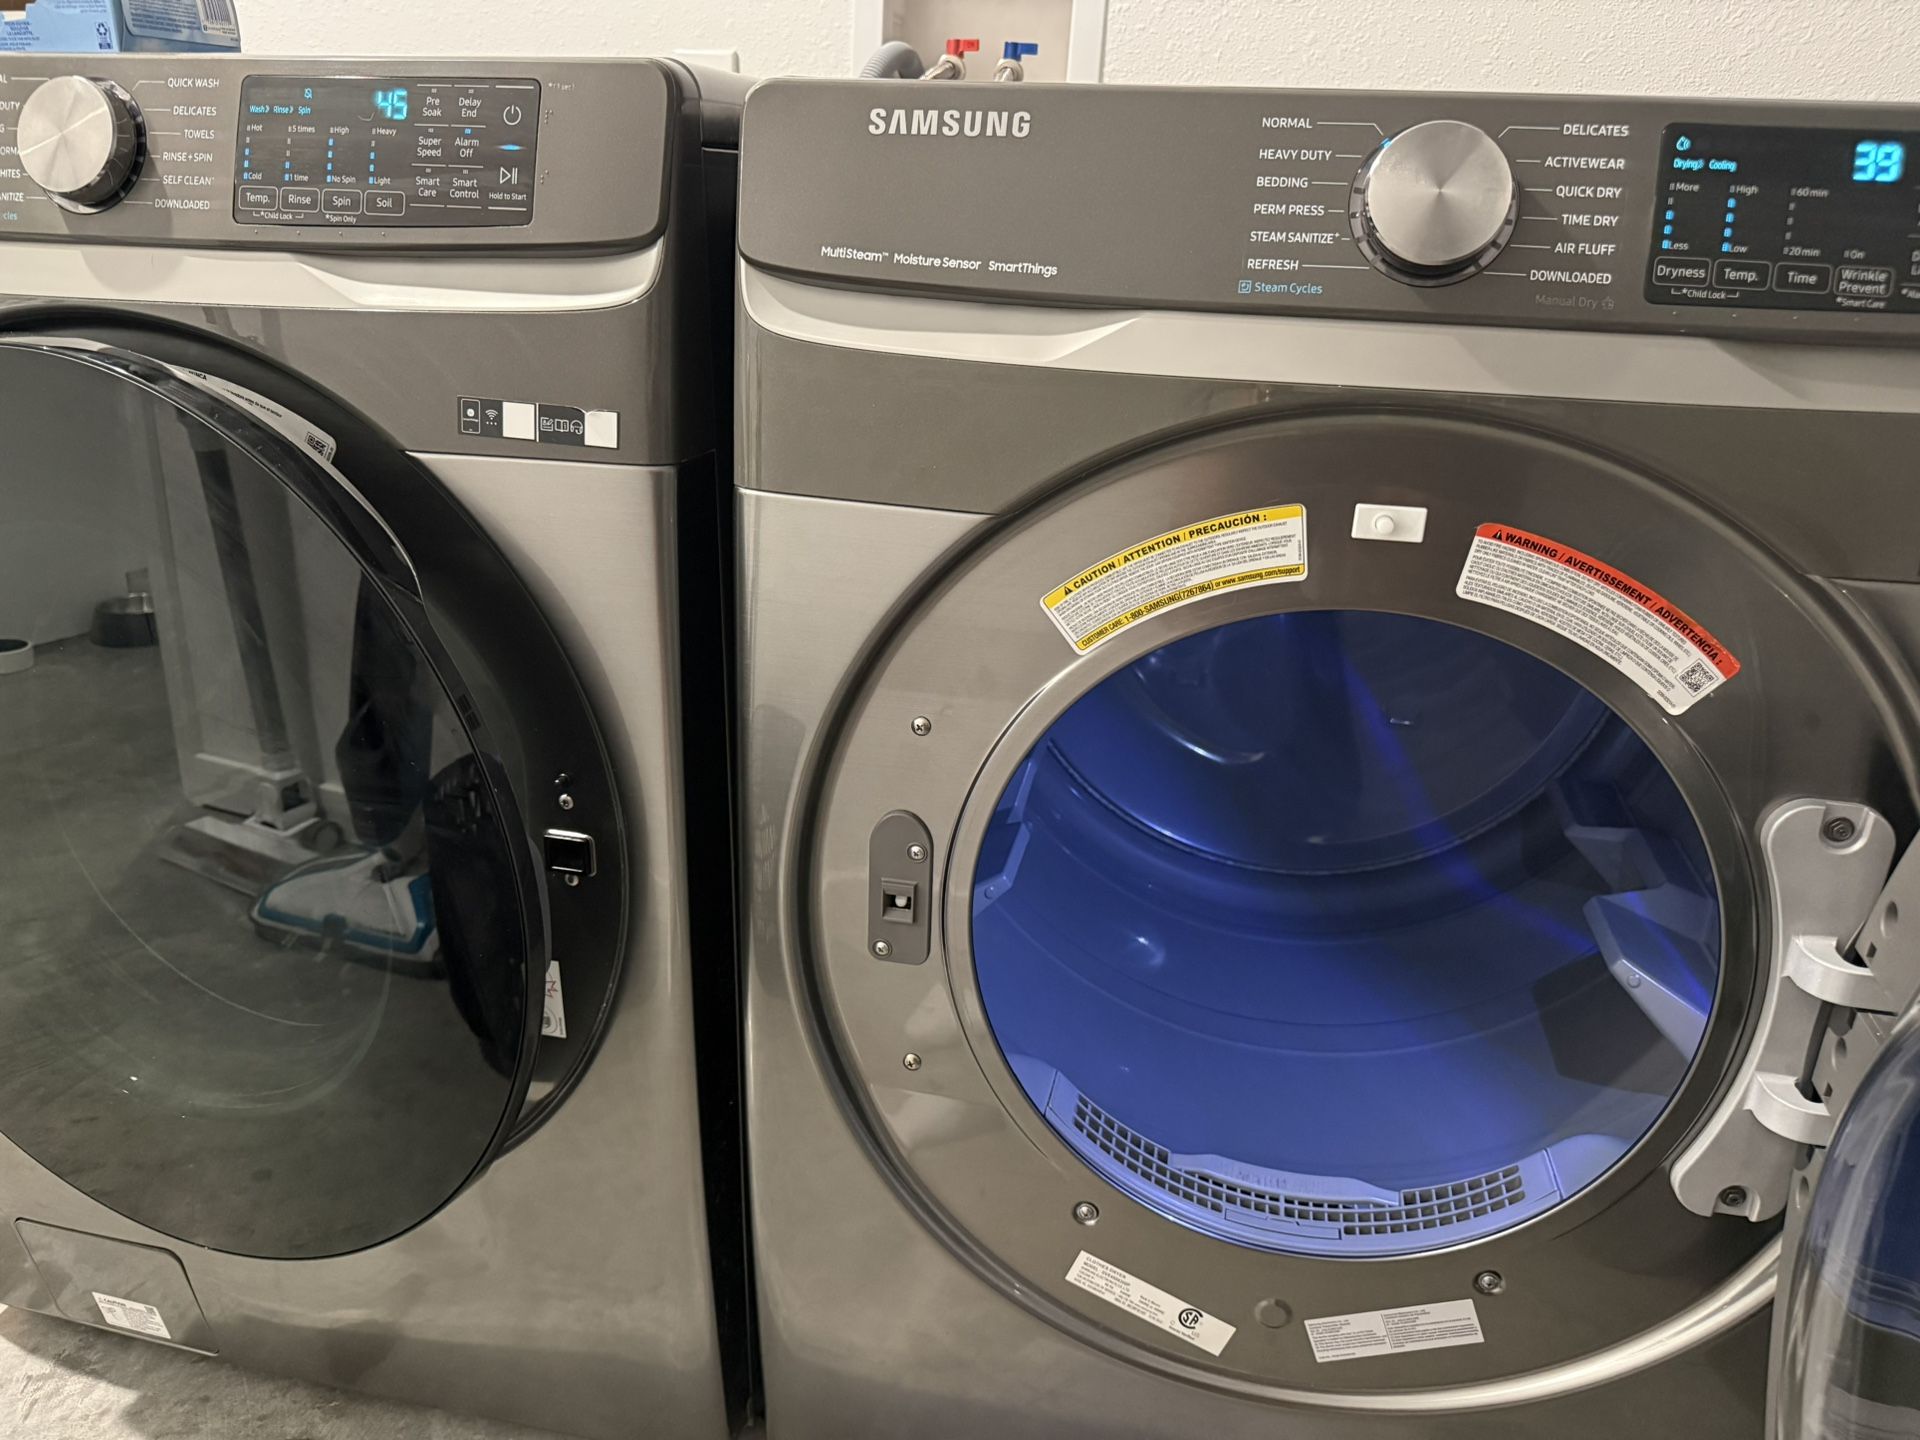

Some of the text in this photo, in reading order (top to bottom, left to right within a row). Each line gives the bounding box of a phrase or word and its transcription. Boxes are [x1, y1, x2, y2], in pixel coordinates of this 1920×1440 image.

[168, 78, 219, 88] QUICK WASH
[375, 88, 408, 120] 45
[426, 97, 439, 106] Pre
[459, 97, 481, 108] Delay
[173, 106, 216, 116] DELICATES
[250, 105, 311, 116] Wash Rinse Spin
[422, 108, 441, 117] Soak
[462, 109, 477, 118] End
[868, 108, 1031, 138] SAMSUNG
[1262, 117, 1313, 129] NORMAL
[184, 129, 214, 139] TOWELS
[335, 126, 349, 134] High
[377, 128, 396, 136] Heavy
[1563, 124, 1630, 137] DELICATES
[419, 136, 441, 146] Super
[455, 137, 479, 146] Alarm
[417, 147, 441, 158] Speed
[460, 149, 473, 158] Off
[1259, 149, 1332, 161] HEAVY DUTY
[1544, 156, 1625, 170] ACTIVEWEAR
[1673, 158, 1737, 173] Drying Cooling
[1852, 140, 1905, 184] 39
[0, 168, 21, 179] HITES
[294, 174, 309, 182] time
[163, 175, 182, 184] SELF
[341, 176, 356, 184] Spin
[374, 176, 391, 186] Light
[416, 176, 440, 185] Smart
[453, 178, 477, 187] Smart
[1256, 176, 1309, 188] BEDDING
[419, 188, 436, 197] Care
[1556, 185, 1622, 198] QUICK DRY
[1675, 182, 1699, 192] More
[1736, 184, 1759, 196] High
[1796, 187, 1829, 198] 60 min
[246, 192, 271, 204] Temp.
[288, 194, 311, 204] Rinse
[450, 189, 479, 198] Control
[155, 199, 210, 210] DOWNLOADED
[332, 195, 351, 207] Spin
[376, 198, 393, 208] Soil
[1253, 204, 1325, 216] PERM PRESS
[342, 215, 356, 223] Only
[1561, 214, 1619, 227] TIME DRY
[1250, 231, 1286, 242] STEAM
[1554, 242, 1616, 256] AIR FLUFF
[1668, 241, 1689, 250] Less
[1730, 243, 1747, 254] Low
[1789, 247, 1820, 257] 20 min
[1850, 250, 1865, 260] On
[893, 253, 941, 268] Moisture
[942, 256, 982, 271] Sensor
[988, 260, 1058, 278] SmartThings
[1247, 258, 1299, 271] REFRESH
[1530, 269, 1612, 285] DOWNLOADED
[1657, 265, 1706, 281] Dryness
[1723, 268, 1759, 282] Temp.
[1787, 272, 1818, 284] Time
[1841, 269, 1888, 282] Wrinkle
[1254, 282, 1323, 295] Steam Cycles
[1839, 281, 1886, 295] Prevent
[1708, 289, 1726, 300] Lock
[1536, 294, 1599, 310] Manual Dry
[1867, 299, 1886, 309] Care
[1073, 562, 1116, 589] CAUTION
[1123, 534, 1181, 564] ATTENTION
[1188, 514, 1260, 539] PRECAUCIÓN
[1505, 532, 1558, 558] WARNING
[1564, 555, 1652, 606] AVERTISSEMENT
[1655, 606, 1719, 661] ADVERTENCIA
[1081, 626, 1109, 647] CUSTOMER
